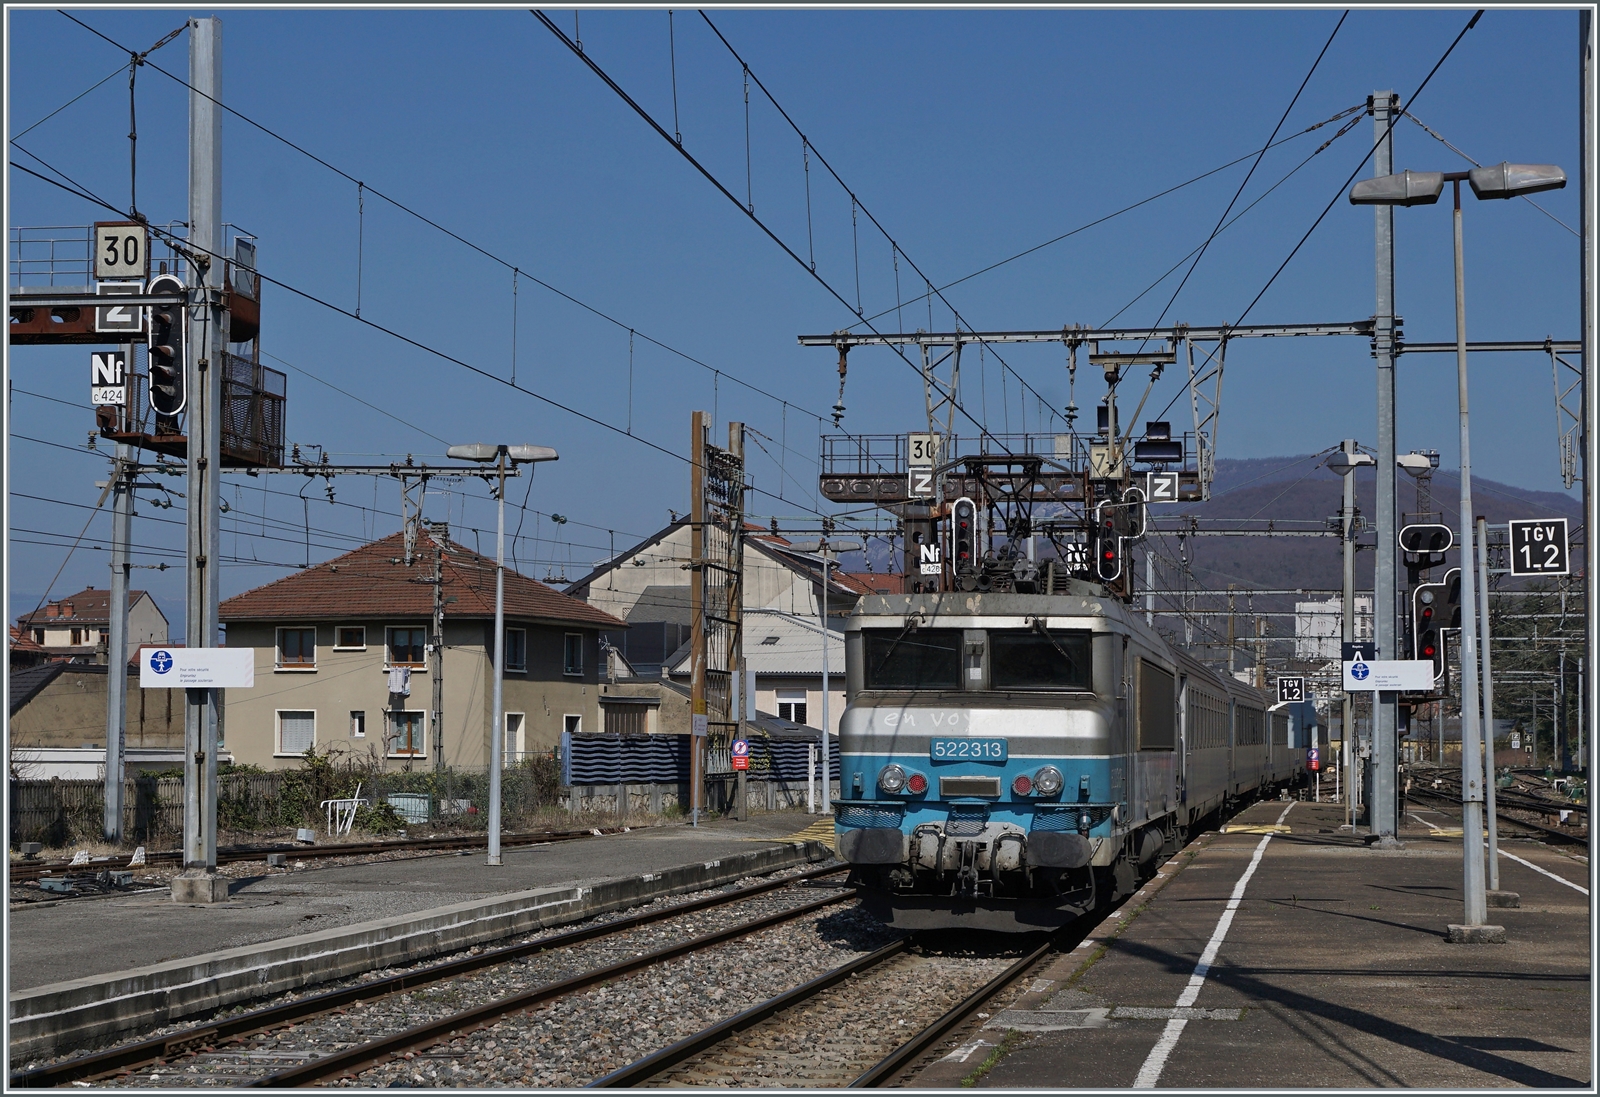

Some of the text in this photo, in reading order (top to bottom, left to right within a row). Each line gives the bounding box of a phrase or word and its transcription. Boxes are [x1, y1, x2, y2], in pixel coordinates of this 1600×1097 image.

[104, 235, 139, 266] 30
[91, 353, 124, 384] Nf
[101, 389, 123, 402] 424
[915, 474, 932, 492] Z
[1153, 478, 1171, 497] Z
[1521, 526, 1555, 541] TGV
[920, 544, 941, 563] Nf
[1283, 680, 1299, 688] TGV
[934, 742, 1002, 758] 522313
